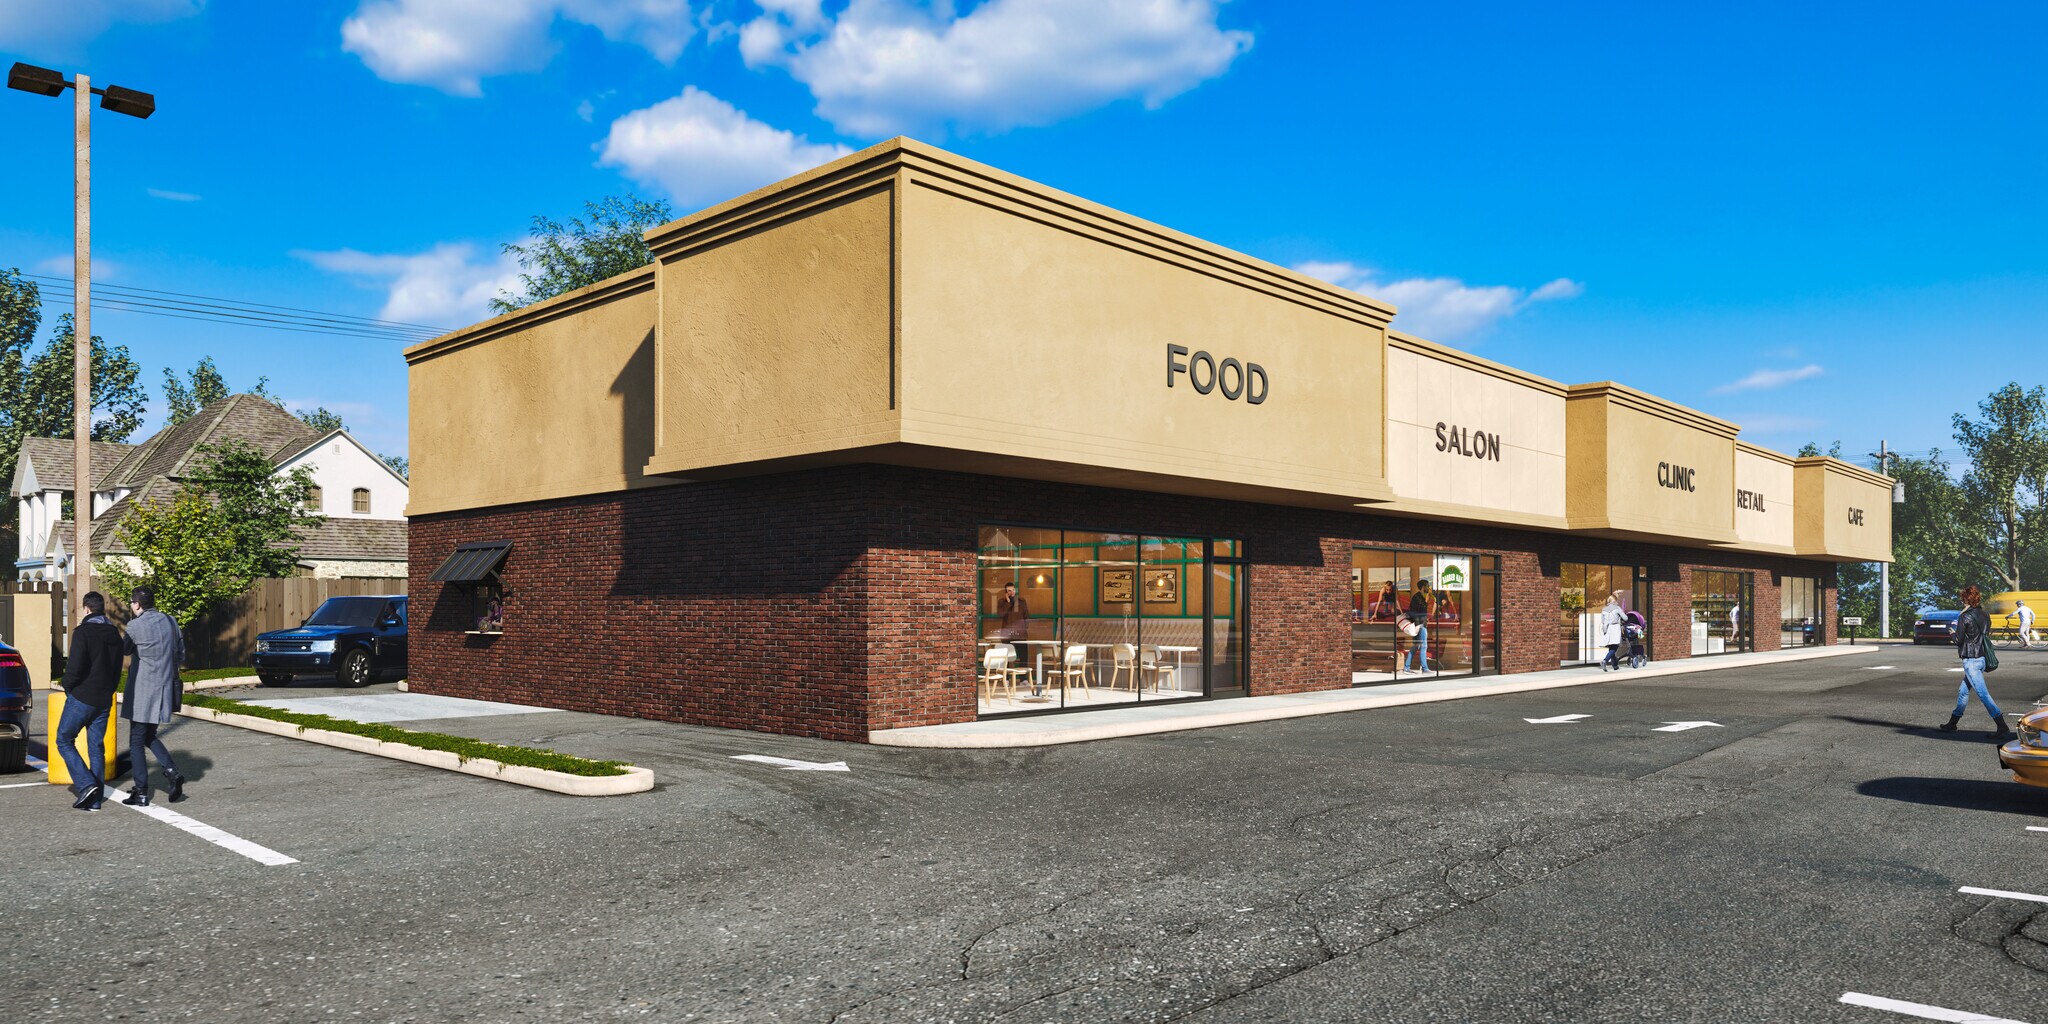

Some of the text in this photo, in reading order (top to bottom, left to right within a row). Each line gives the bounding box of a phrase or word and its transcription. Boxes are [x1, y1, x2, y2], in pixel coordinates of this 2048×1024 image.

[1167, 343, 1269, 405] FOOD
[1435, 421, 1500, 462] SALON
[1657, 461, 1696, 493] CLINIC
[1737, 488, 1766, 513] RETAIL
[1848, 506, 1864, 527] CAFE
